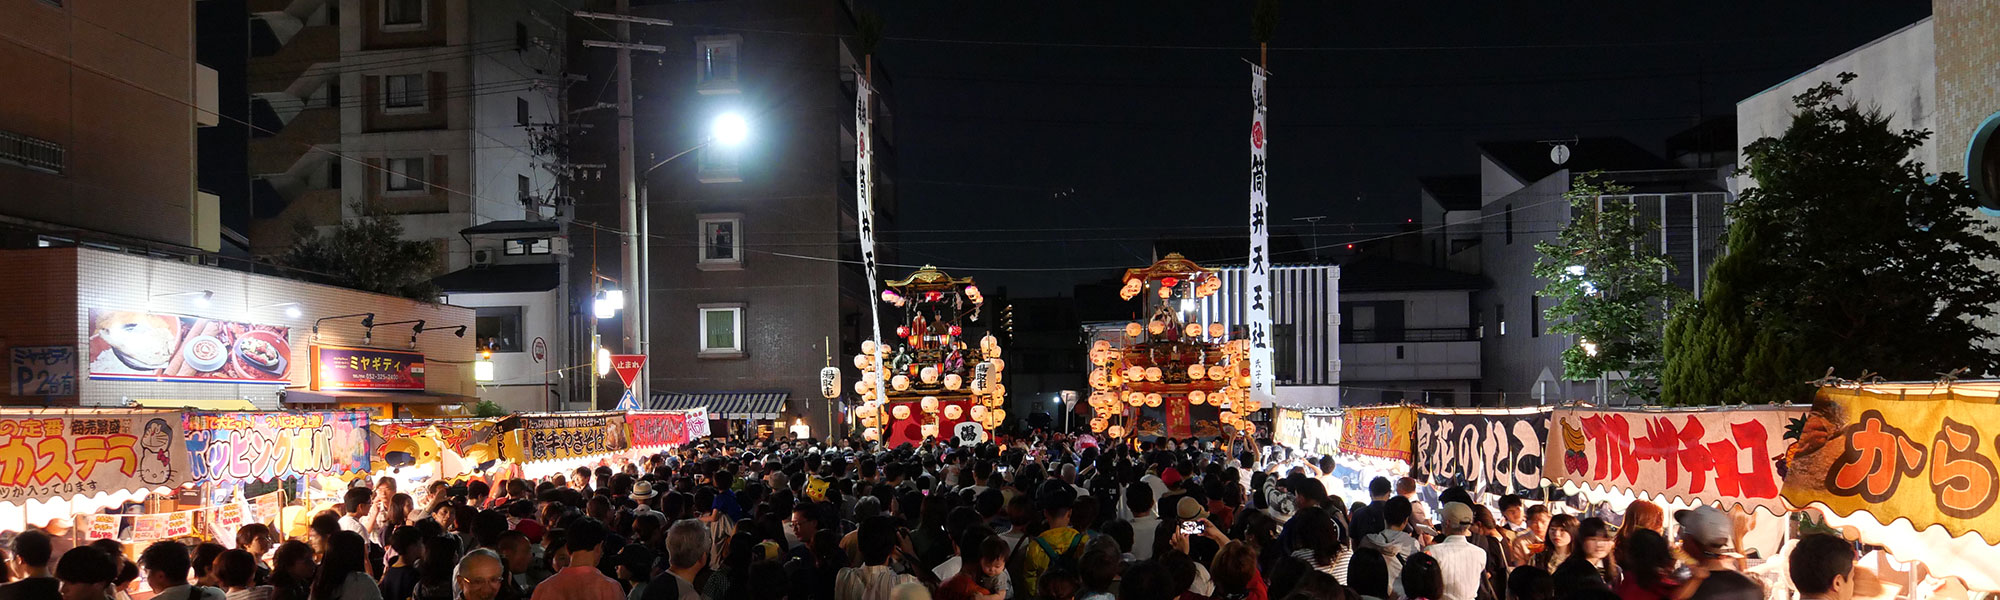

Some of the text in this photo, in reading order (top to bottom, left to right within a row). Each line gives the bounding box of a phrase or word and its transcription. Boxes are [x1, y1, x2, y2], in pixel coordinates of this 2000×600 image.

[350, 355, 401, 372] ミヤギディ
[616, 360, 640, 369] 止まれ
[71, 418, 120, 435] 商売繁盛
[530, 428, 606, 459] 横手やきそば
[0, 433, 139, 489] カステラ
[1825, 408, 2000, 519] から
